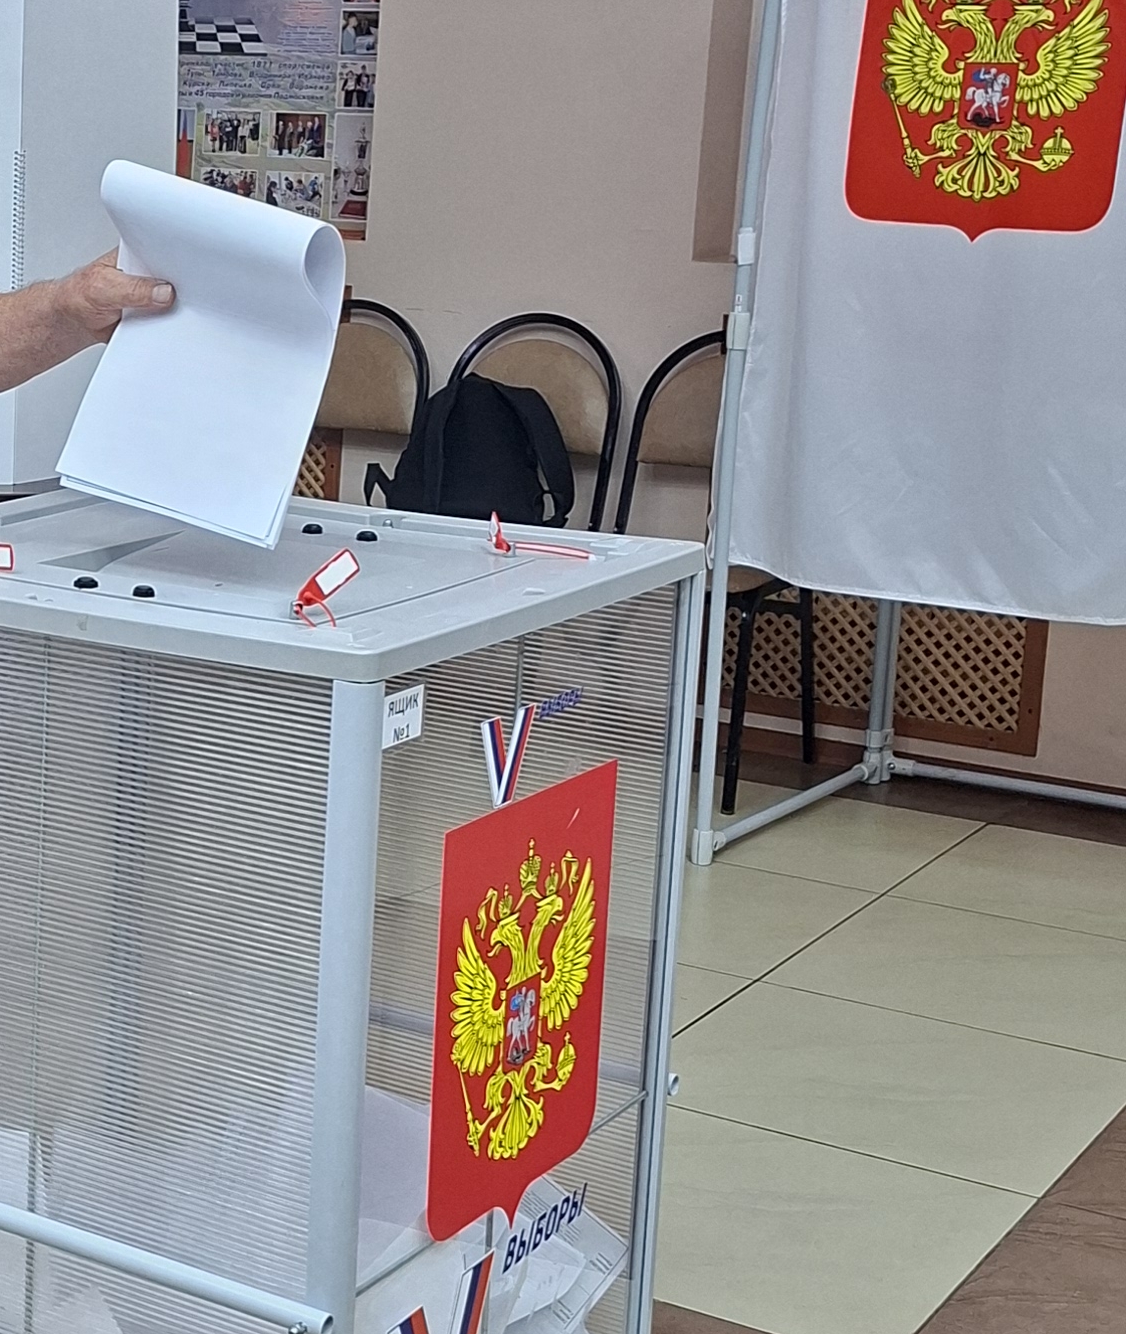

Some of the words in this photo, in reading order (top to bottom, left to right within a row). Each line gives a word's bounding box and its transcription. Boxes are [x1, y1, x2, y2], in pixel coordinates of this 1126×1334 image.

[387, 691, 420, 718] ЯЩИК
[392, 722, 411, 744] №1
[502, 1181, 588, 1275] ВЫБОРЫ
